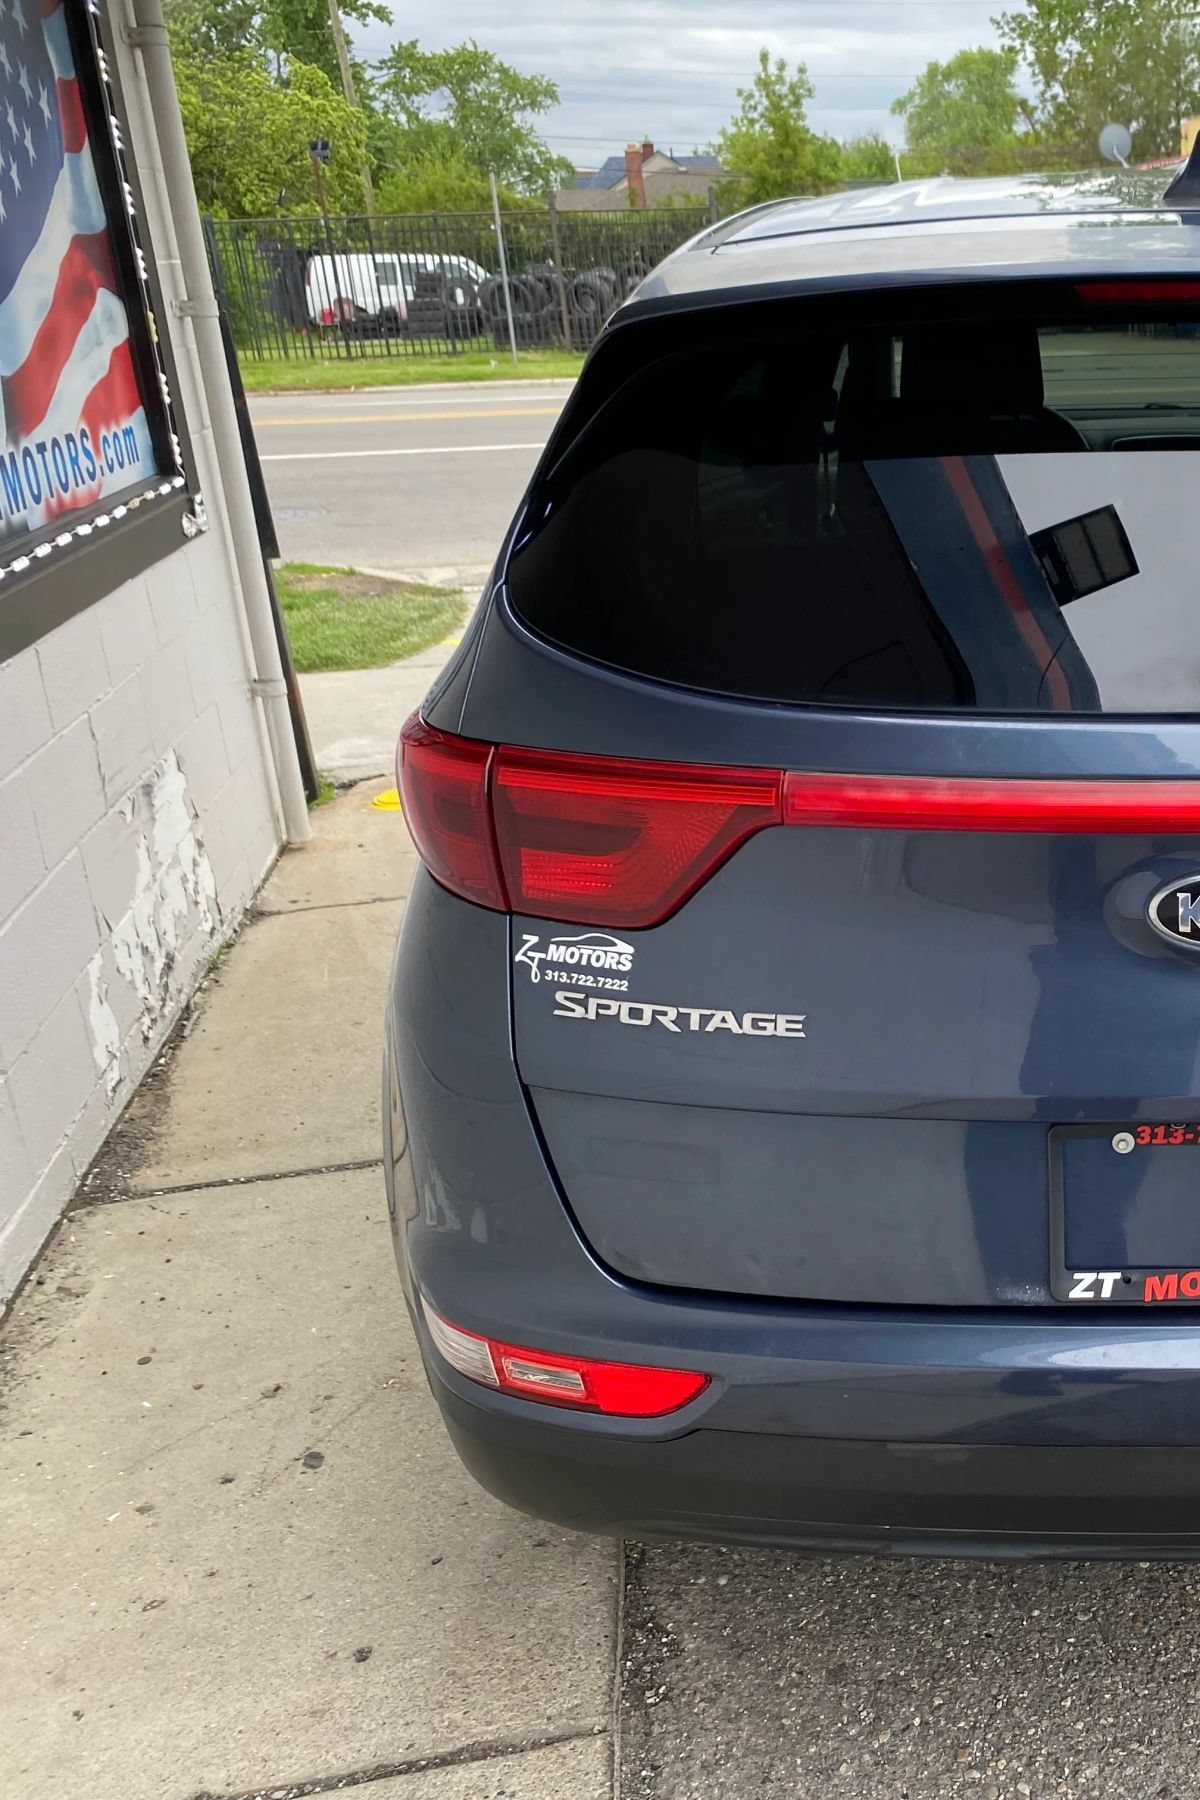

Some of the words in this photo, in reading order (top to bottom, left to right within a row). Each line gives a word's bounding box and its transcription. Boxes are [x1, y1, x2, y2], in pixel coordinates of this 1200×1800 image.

[546, 944, 633, 972] MOTORS
[544, 969, 629, 992] 313.722.7222
[553, 990, 807, 1038] SPORTAGE
[1068, 1271, 1122, 1299] ZT
